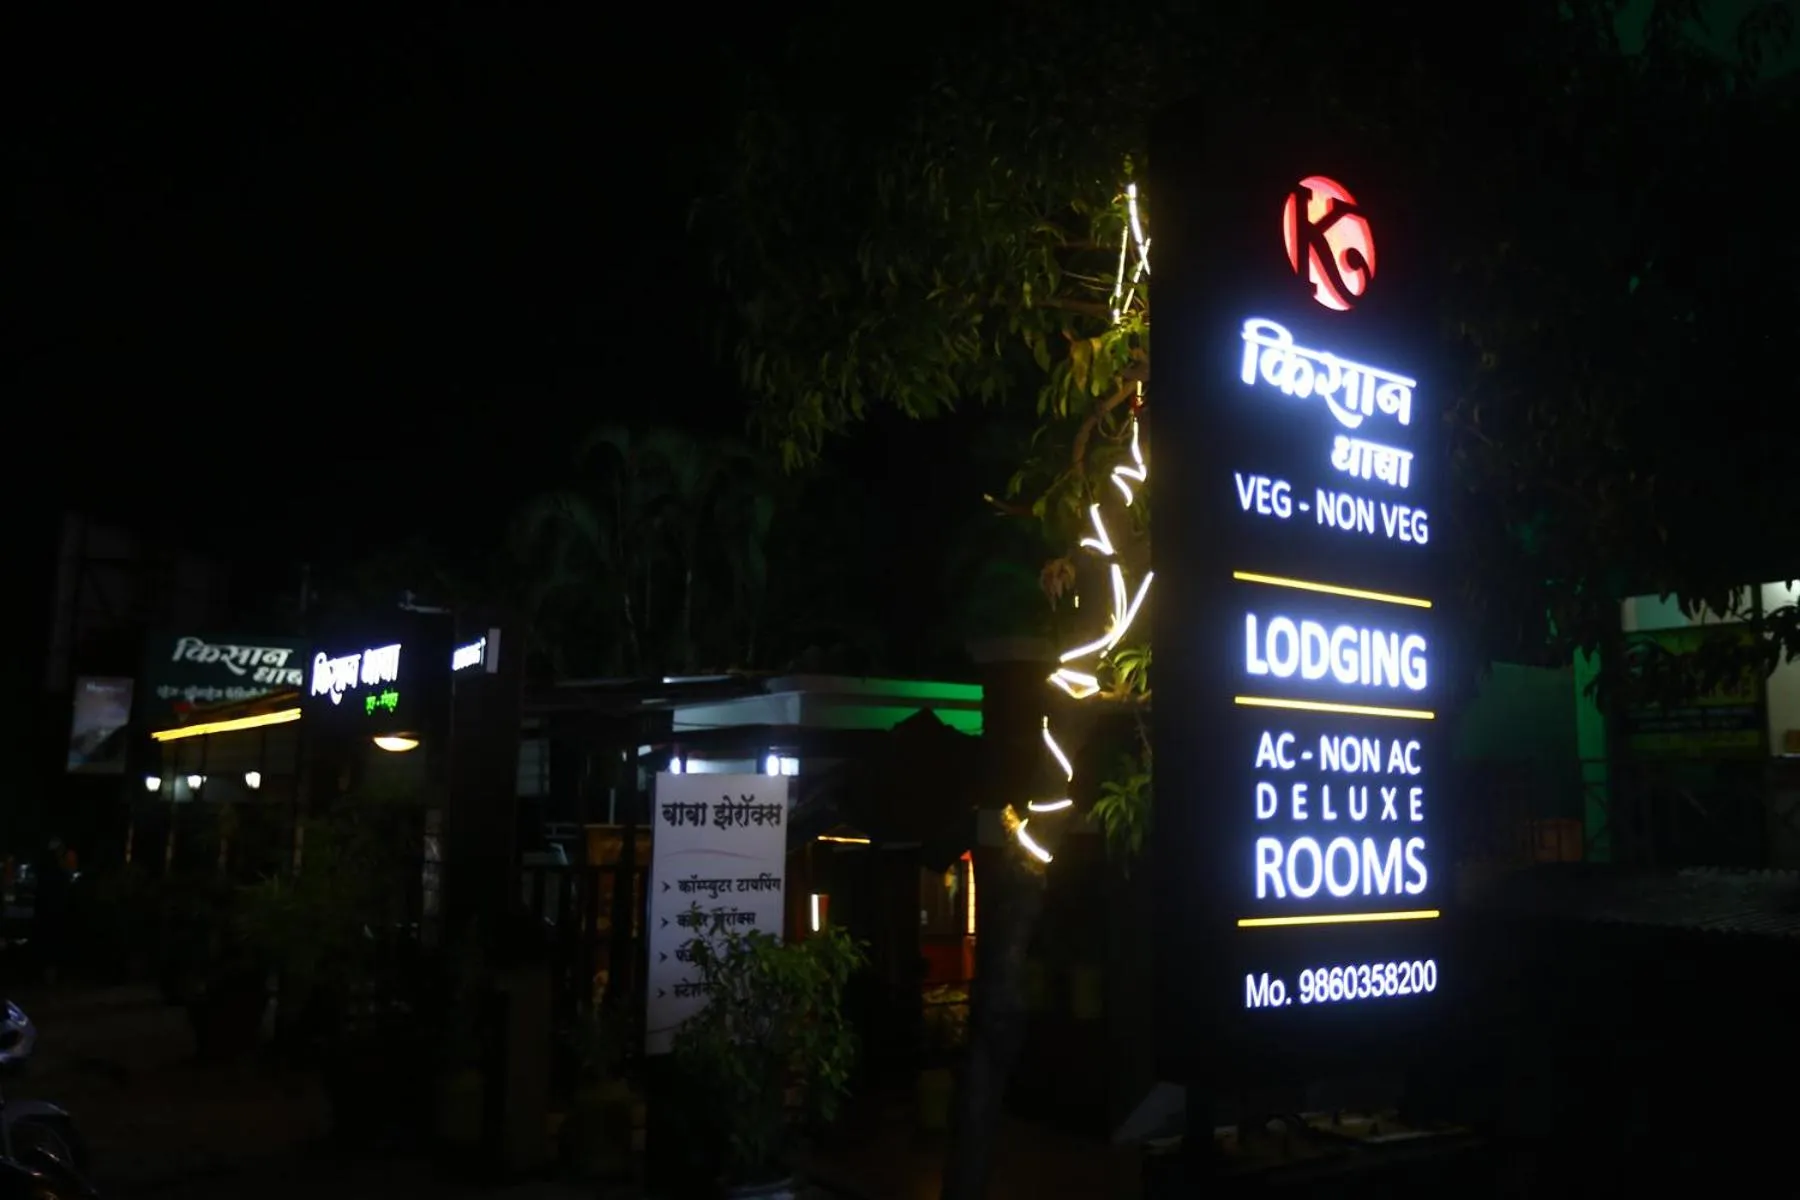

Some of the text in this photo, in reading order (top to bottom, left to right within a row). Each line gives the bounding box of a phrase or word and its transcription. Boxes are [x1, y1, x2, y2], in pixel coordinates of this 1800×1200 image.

[1240, 318, 1417, 428] किसान
[1330, 434, 1414, 489] धाबा
[1234, 472, 1292, 519] VEG
[1315, 488, 1376, 535] NON
[1379, 502, 1430, 545] VEG
[171, 636, 295, 677] किसान
[1244, 612, 1430, 691] LODGING
[1254, 731, 1296, 770] AC
[1319, 734, 1381, 774] NON
[1386, 739, 1422, 776] AC
[661, 794, 783, 830] बाबा झेरॉक्स
[735, 872, 782, 893] टायपिंग
[1255, 836, 1429, 899] ROOMS
[1245, 958, 1438, 1009] Mo. 9860358200
